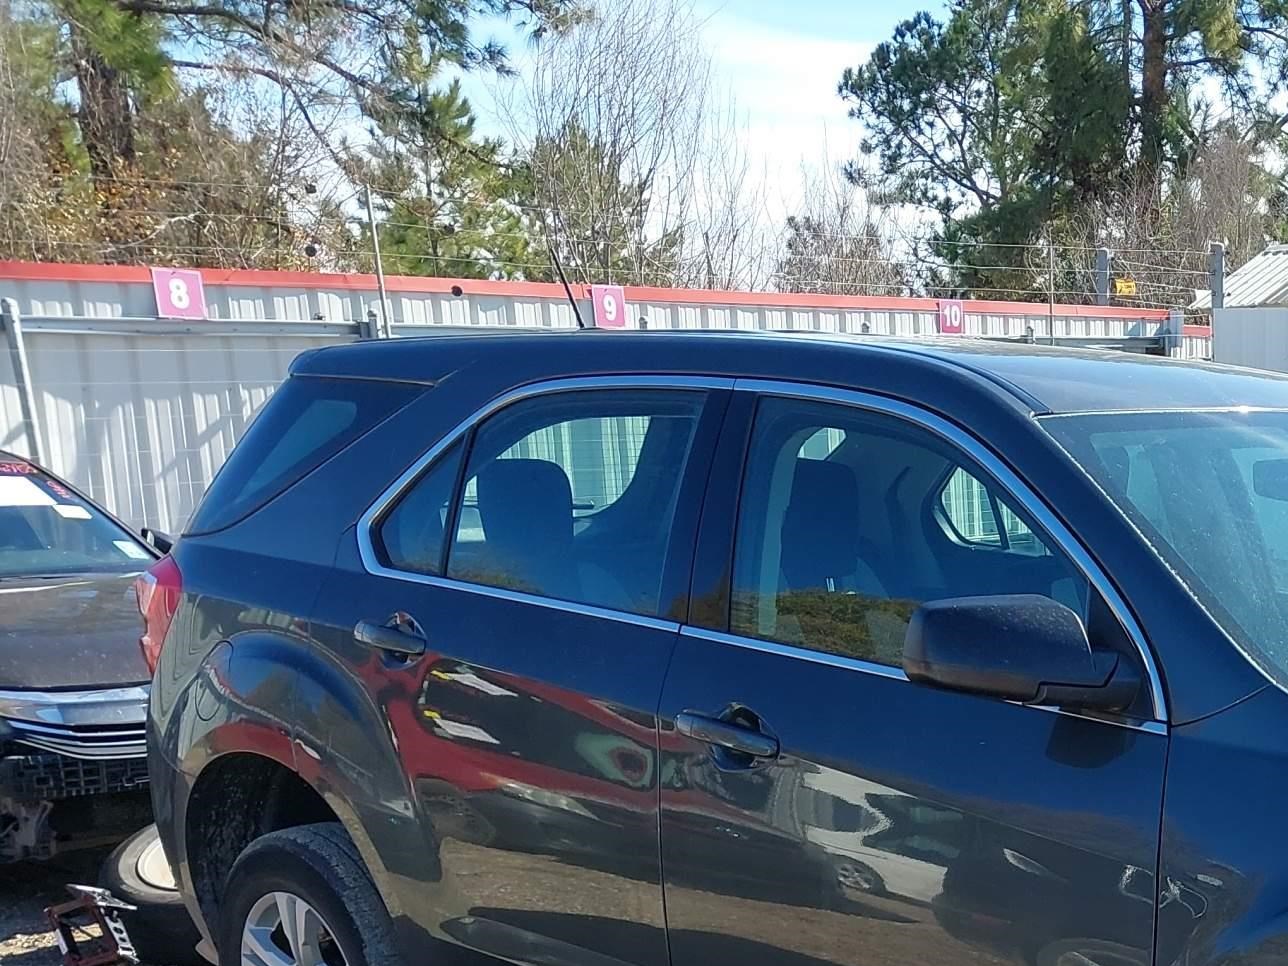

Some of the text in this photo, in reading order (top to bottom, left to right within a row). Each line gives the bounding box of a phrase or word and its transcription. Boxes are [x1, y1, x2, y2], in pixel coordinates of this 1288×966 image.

[169, 278, 190, 309] 8
[603, 294, 617, 321] 9
[943, 304, 961, 327] 10
